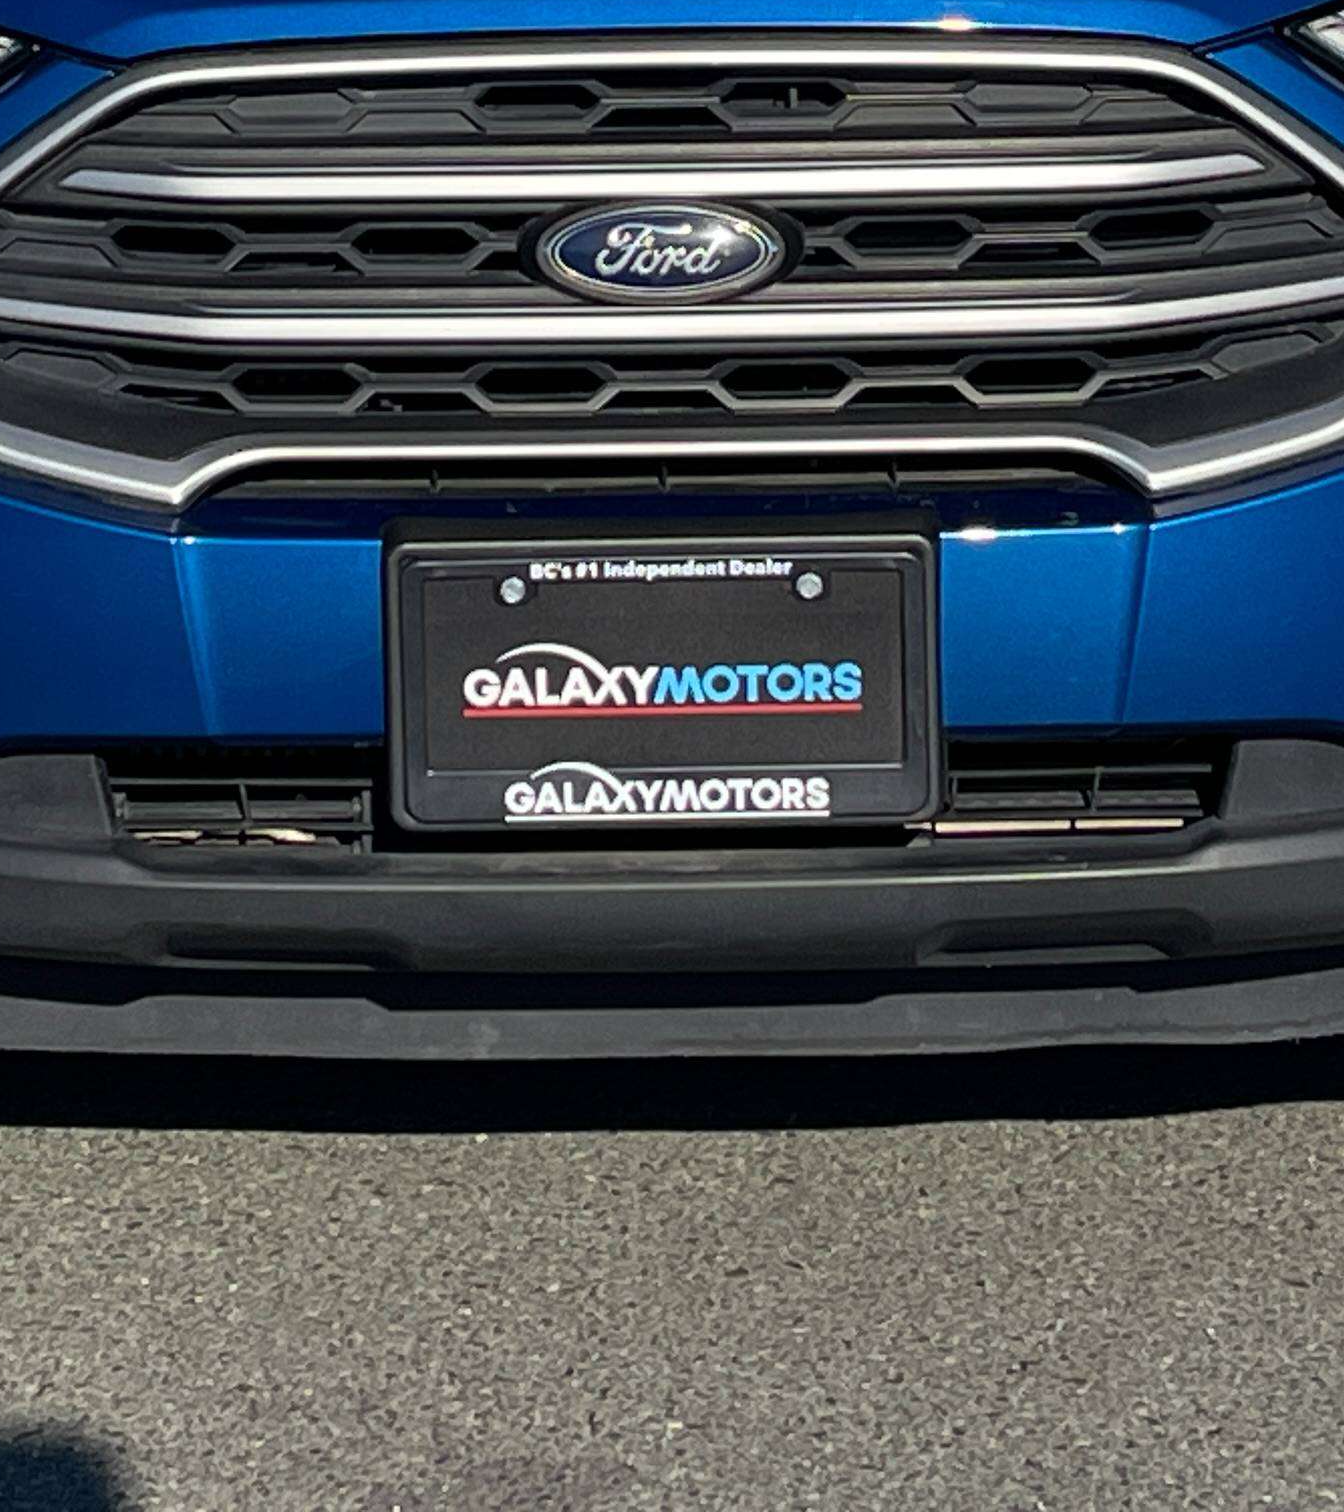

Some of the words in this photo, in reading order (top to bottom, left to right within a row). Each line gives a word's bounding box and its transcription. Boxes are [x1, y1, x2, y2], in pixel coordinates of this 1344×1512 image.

[595, 222, 726, 276] Ford
[530, 561, 572, 579] BC's
[575, 561, 598, 578] #1
[604, 559, 725, 581] Independent
[729, 558, 793, 576] Dealer
